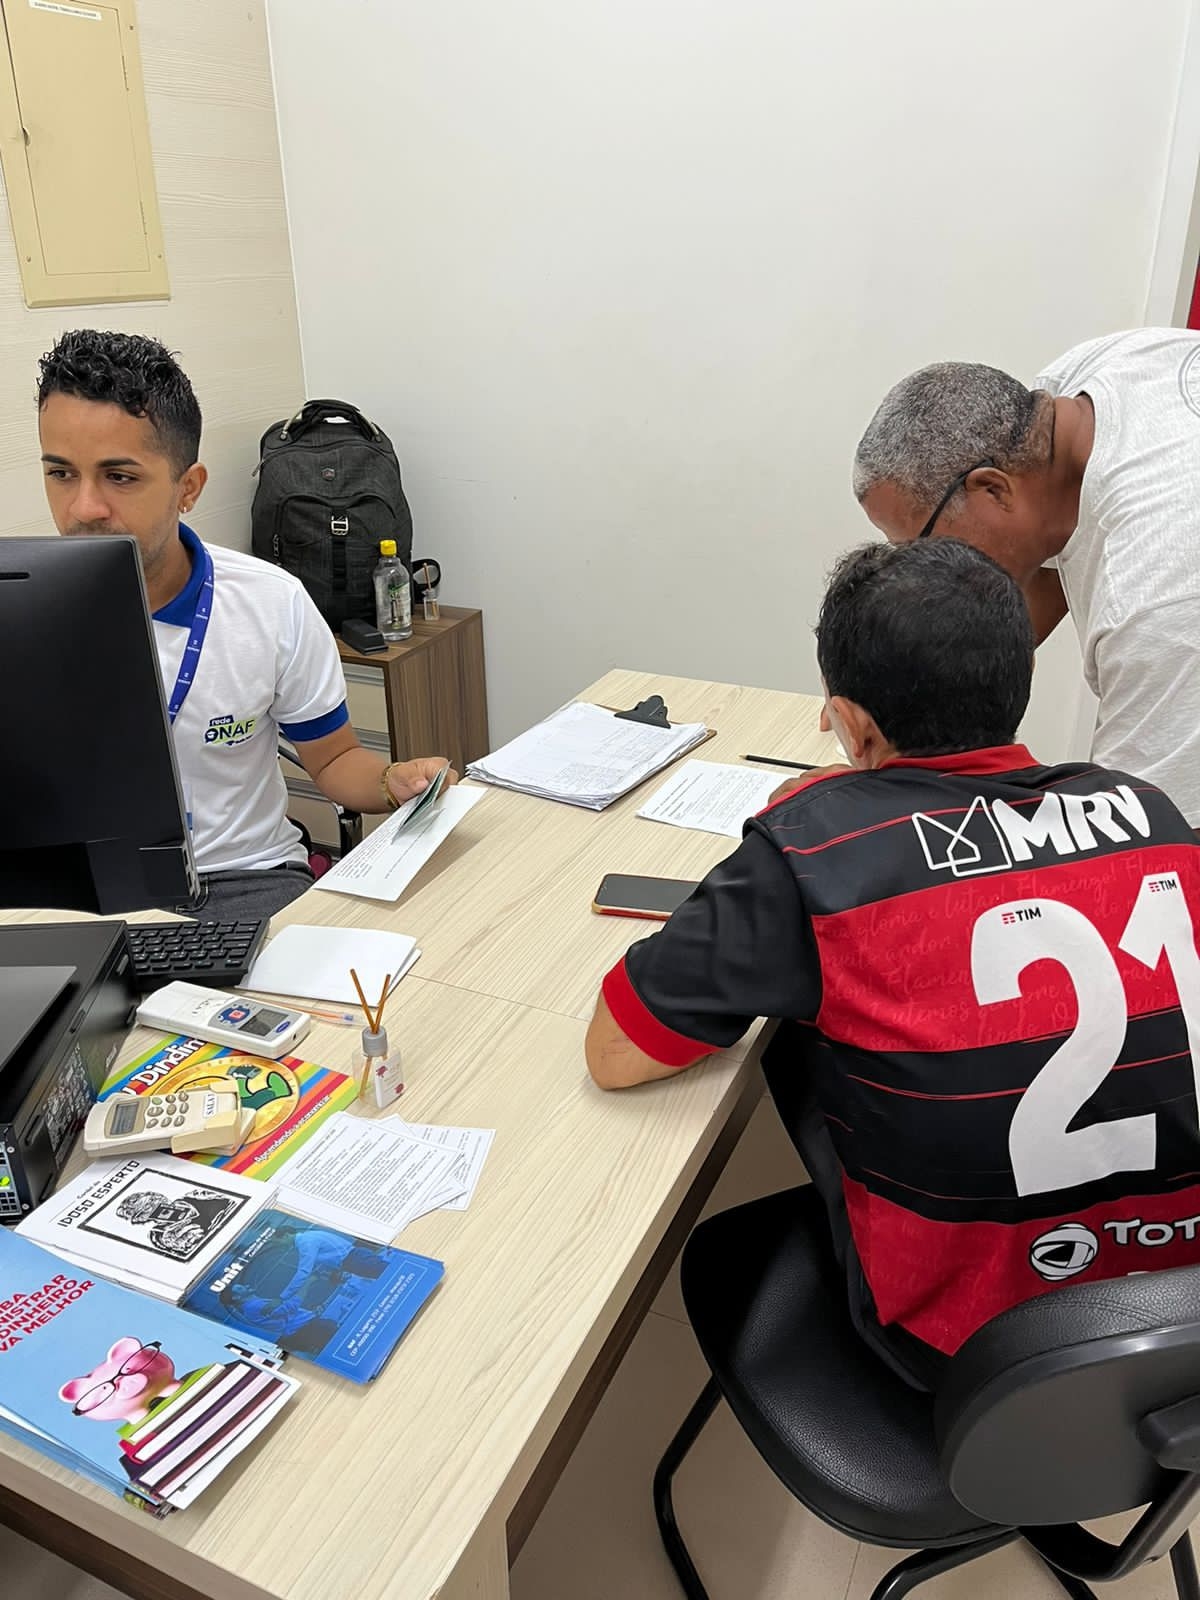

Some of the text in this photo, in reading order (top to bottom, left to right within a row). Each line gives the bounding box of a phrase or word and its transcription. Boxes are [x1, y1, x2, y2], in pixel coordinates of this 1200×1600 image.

[992, 785, 1150, 862] MRV
[1158, 879, 1178, 892] TIM
[1016, 906, 1042, 922] TIM
[971, 871, 1200, 1197] 21
[130, 1038, 206, 1087] Dindin
[57, 1160, 140, 1228] IDOSO ESPERTO
[1103, 1215, 1200, 1246] TOT
[209, 1262, 244, 1293] Unit
[0, 1279, 78, 1339] DINHEIRO
[0, 1280, 96, 1352] VA MELHOR
